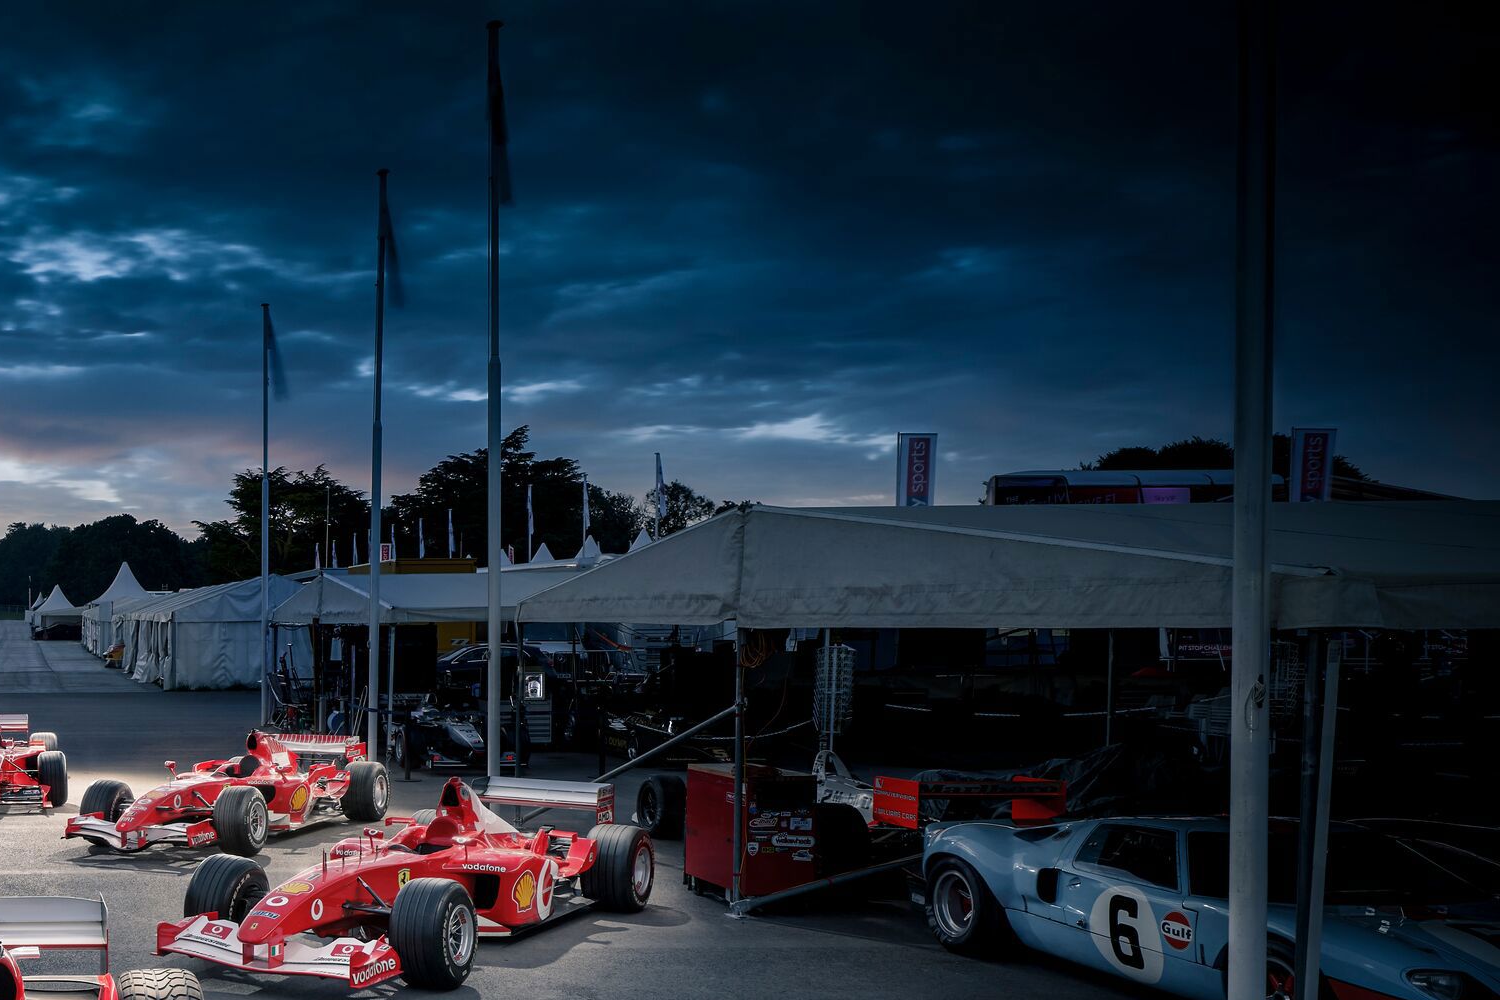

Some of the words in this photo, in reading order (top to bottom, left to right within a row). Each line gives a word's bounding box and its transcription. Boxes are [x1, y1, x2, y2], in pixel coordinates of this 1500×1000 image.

[913, 441, 927, 495] sports
[1308, 437, 1324, 489] sports
[462, 863, 506, 872] vodafone
[1110, 895, 1144, 970] 6
[1161, 922, 1192, 940] Gulf
[353, 958, 396, 985] vodafone
